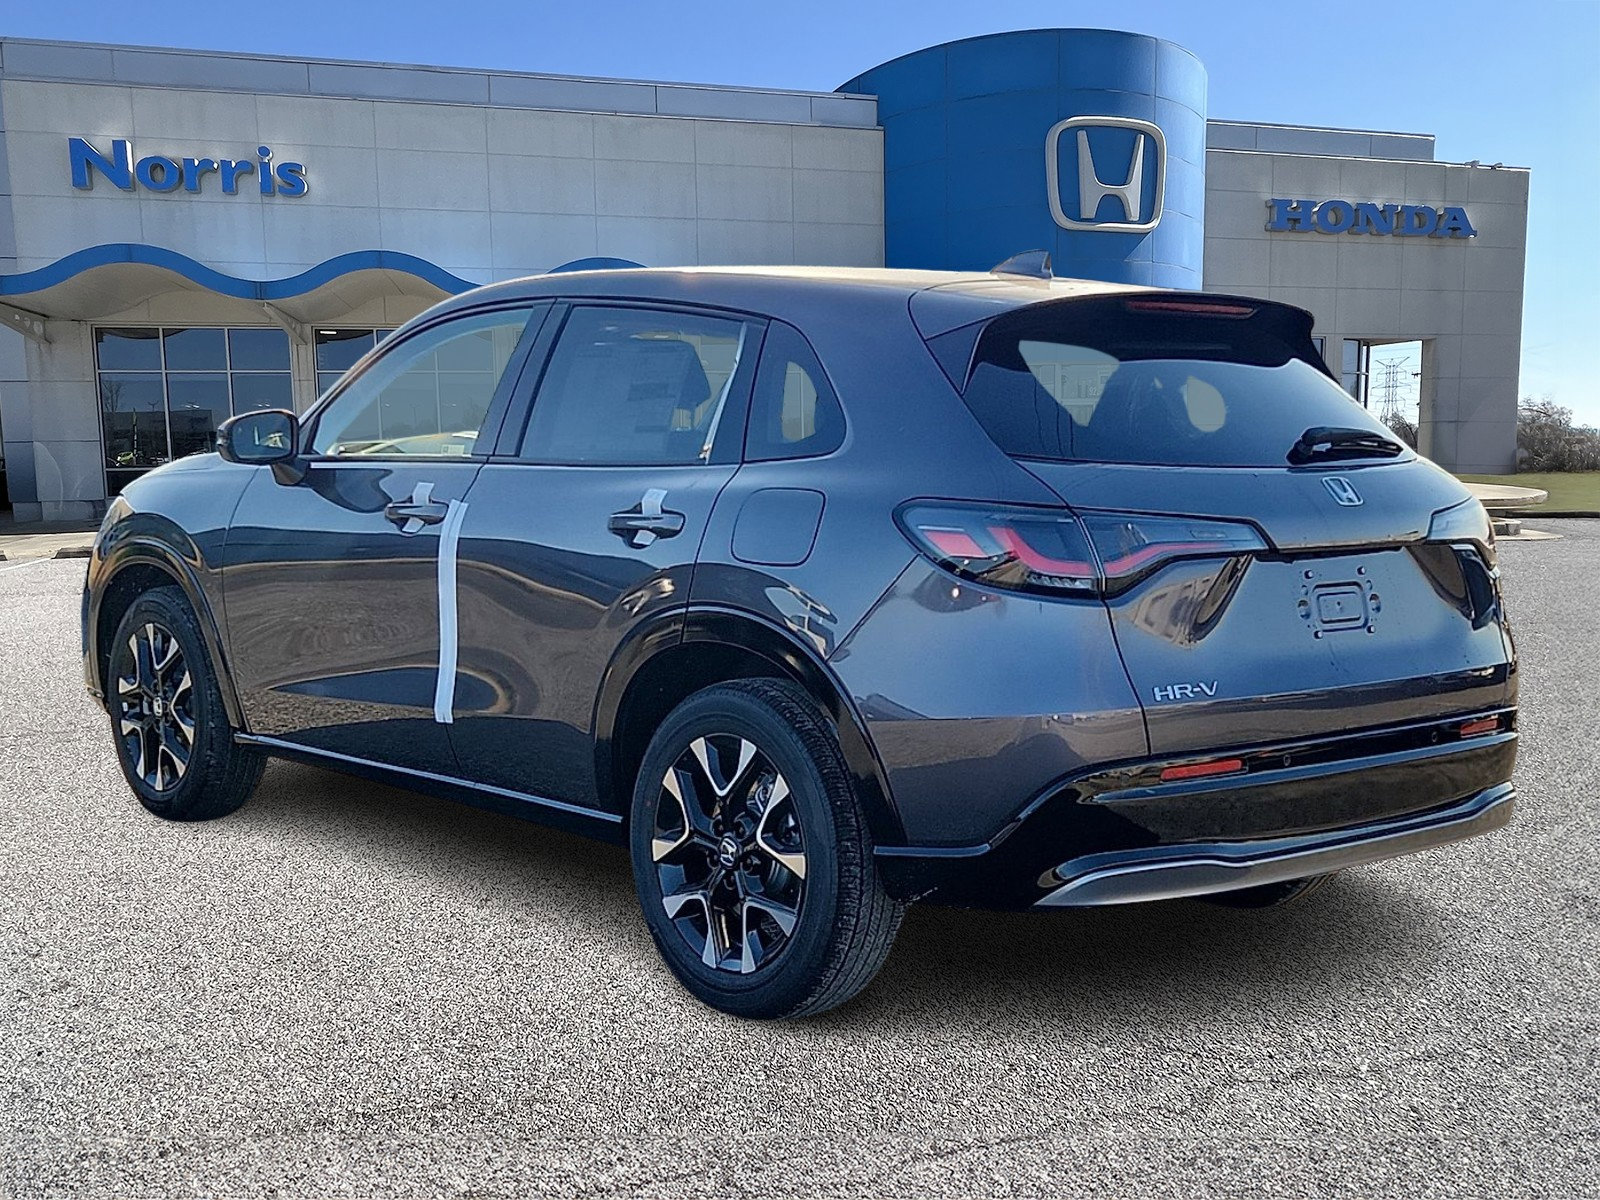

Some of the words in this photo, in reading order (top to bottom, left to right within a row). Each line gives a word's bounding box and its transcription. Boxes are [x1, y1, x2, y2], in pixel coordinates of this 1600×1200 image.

[68, 137, 309, 197] Norris
[1265, 199, 1477, 239] HONDA
[1153, 681, 1218, 702] HR-V
